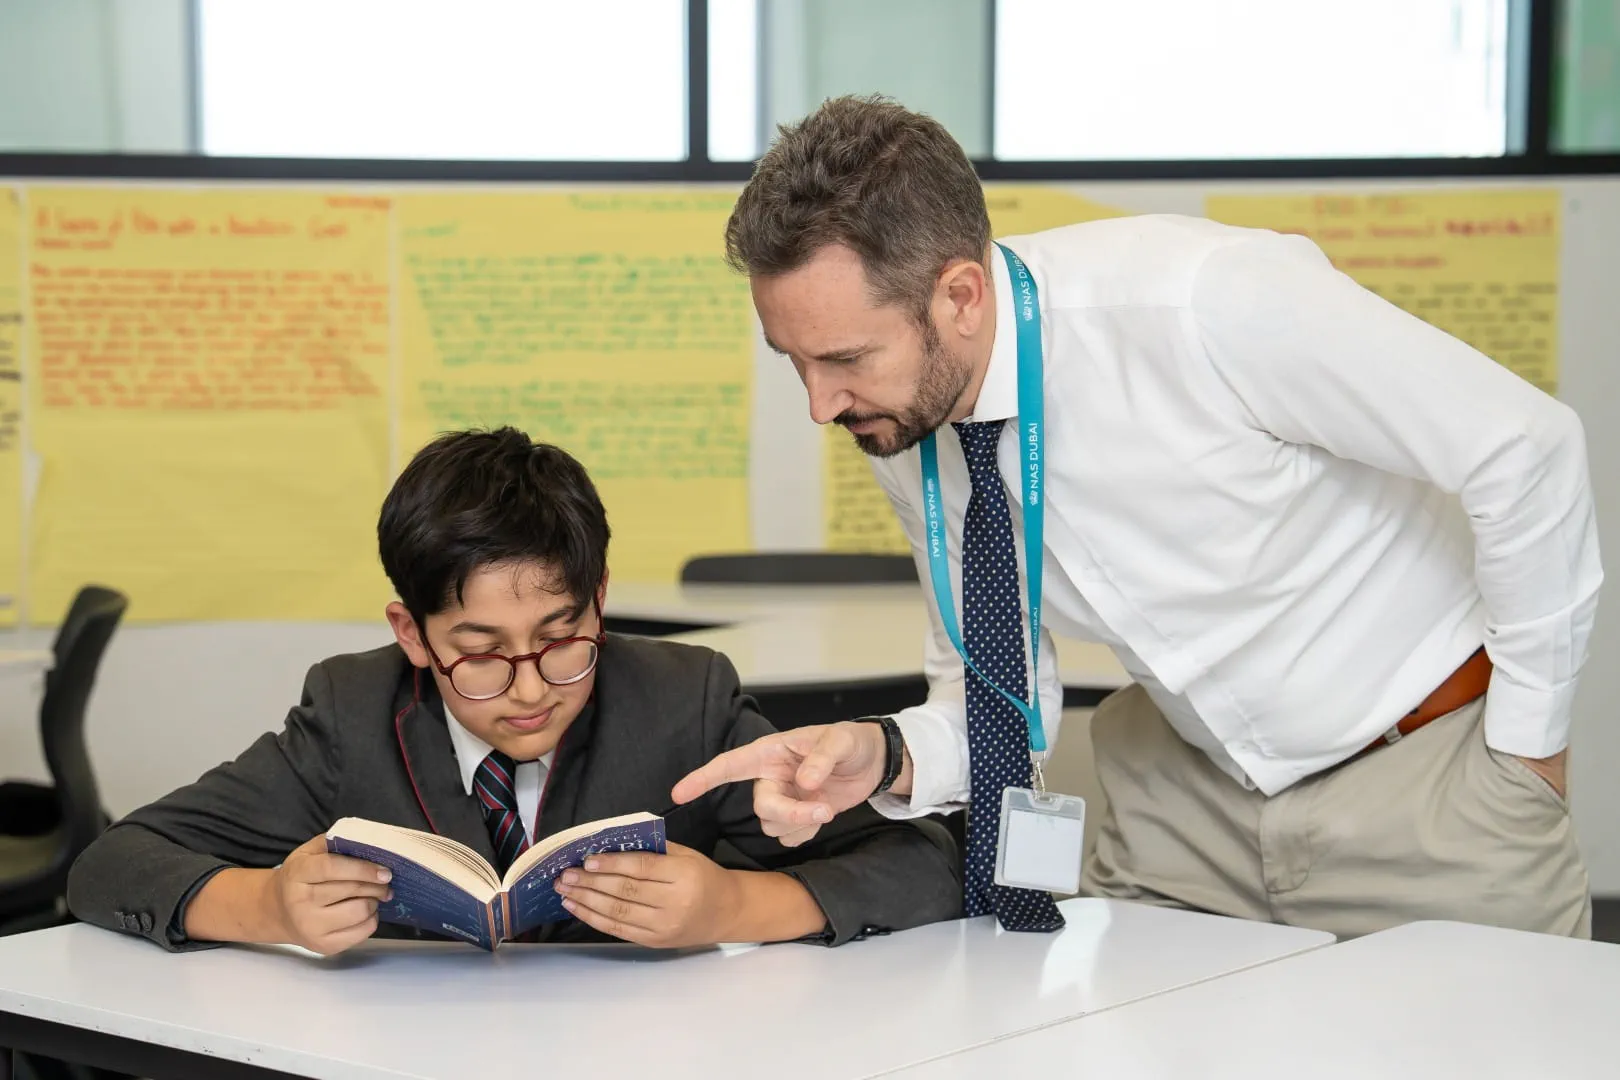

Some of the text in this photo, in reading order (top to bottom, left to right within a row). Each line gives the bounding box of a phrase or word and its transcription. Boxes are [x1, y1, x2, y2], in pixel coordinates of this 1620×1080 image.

[1021, 281, 1033, 305] NAS
[1028, 423, 1039, 489] NAS DUBAI
[928, 494, 941, 557] NAS DUBAI
